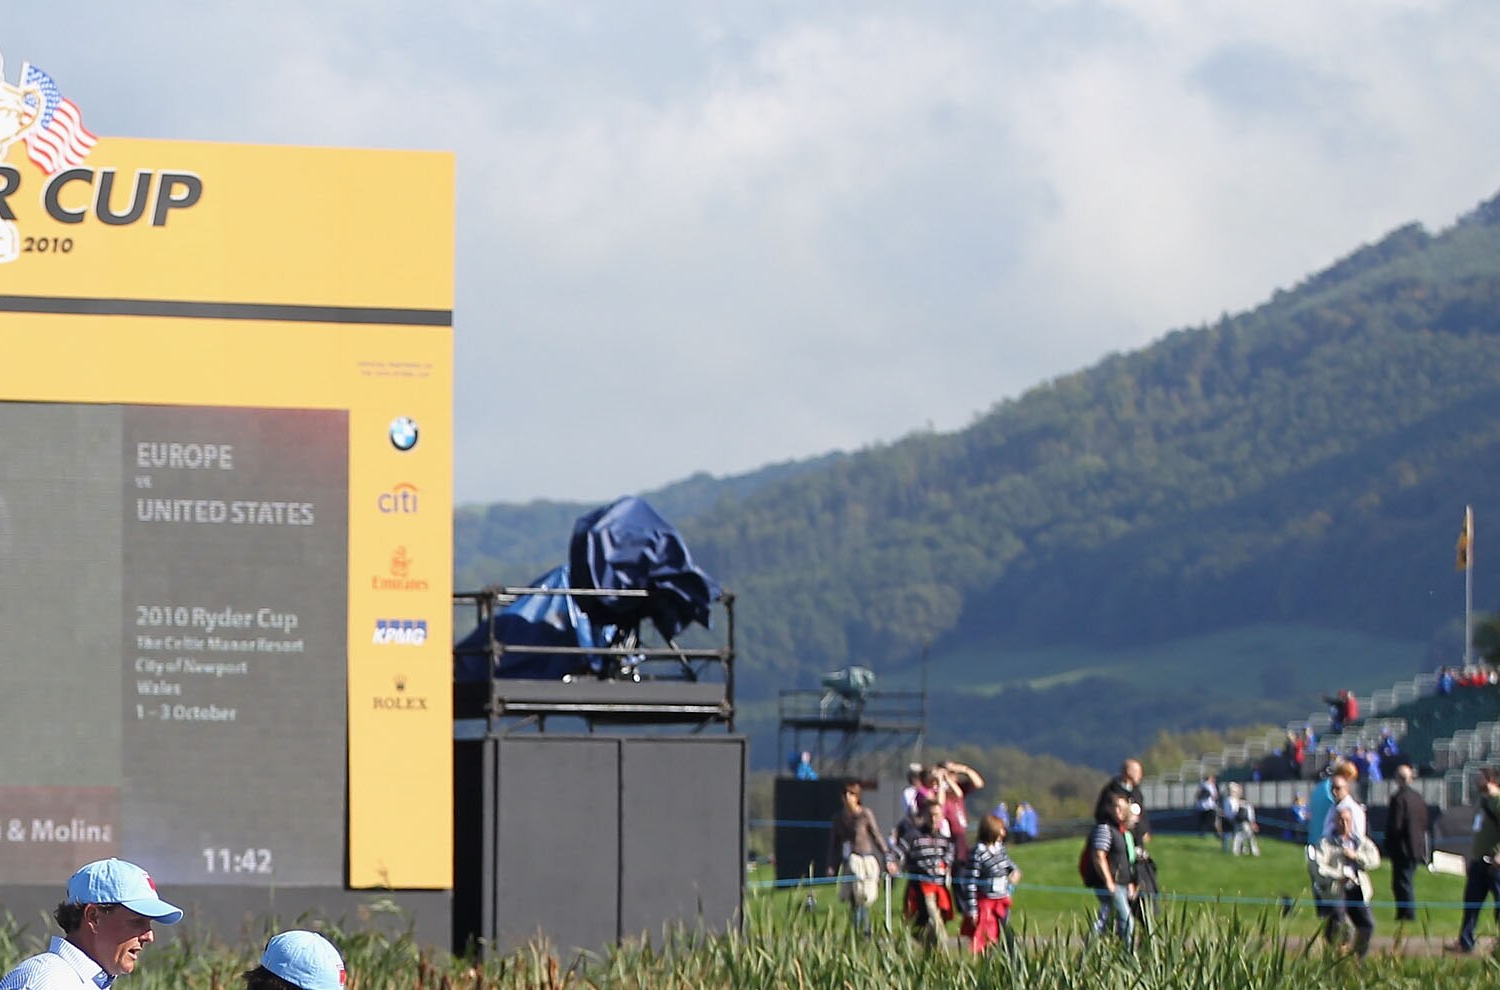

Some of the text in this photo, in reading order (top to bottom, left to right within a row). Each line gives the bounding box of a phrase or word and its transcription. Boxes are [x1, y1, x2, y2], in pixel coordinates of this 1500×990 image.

[43, 166, 204, 228] CUP
[23, 236, 75, 254] 2010
[137, 441, 234, 470] EUROPE
[137, 498, 316, 526] UNITED STATES
[378, 490, 418, 514] citi
[371, 575, 429, 590] Emirates
[136, 605, 300, 635] 2010 Ryder Cup
[136, 634, 305, 653] The Celtic Manor Resort
[372, 623, 427, 645] KPMG
[134, 656, 249, 677] City of Newport
[136, 680, 182, 696] Wales
[136, 704, 145, 720] 1
[159, 704, 171, 721] 3
[172, 704, 238, 721] October
[372, 697, 429, 710] ROLEX
[7, 818, 26, 842] &
[202, 848, 274, 873] 11:42
